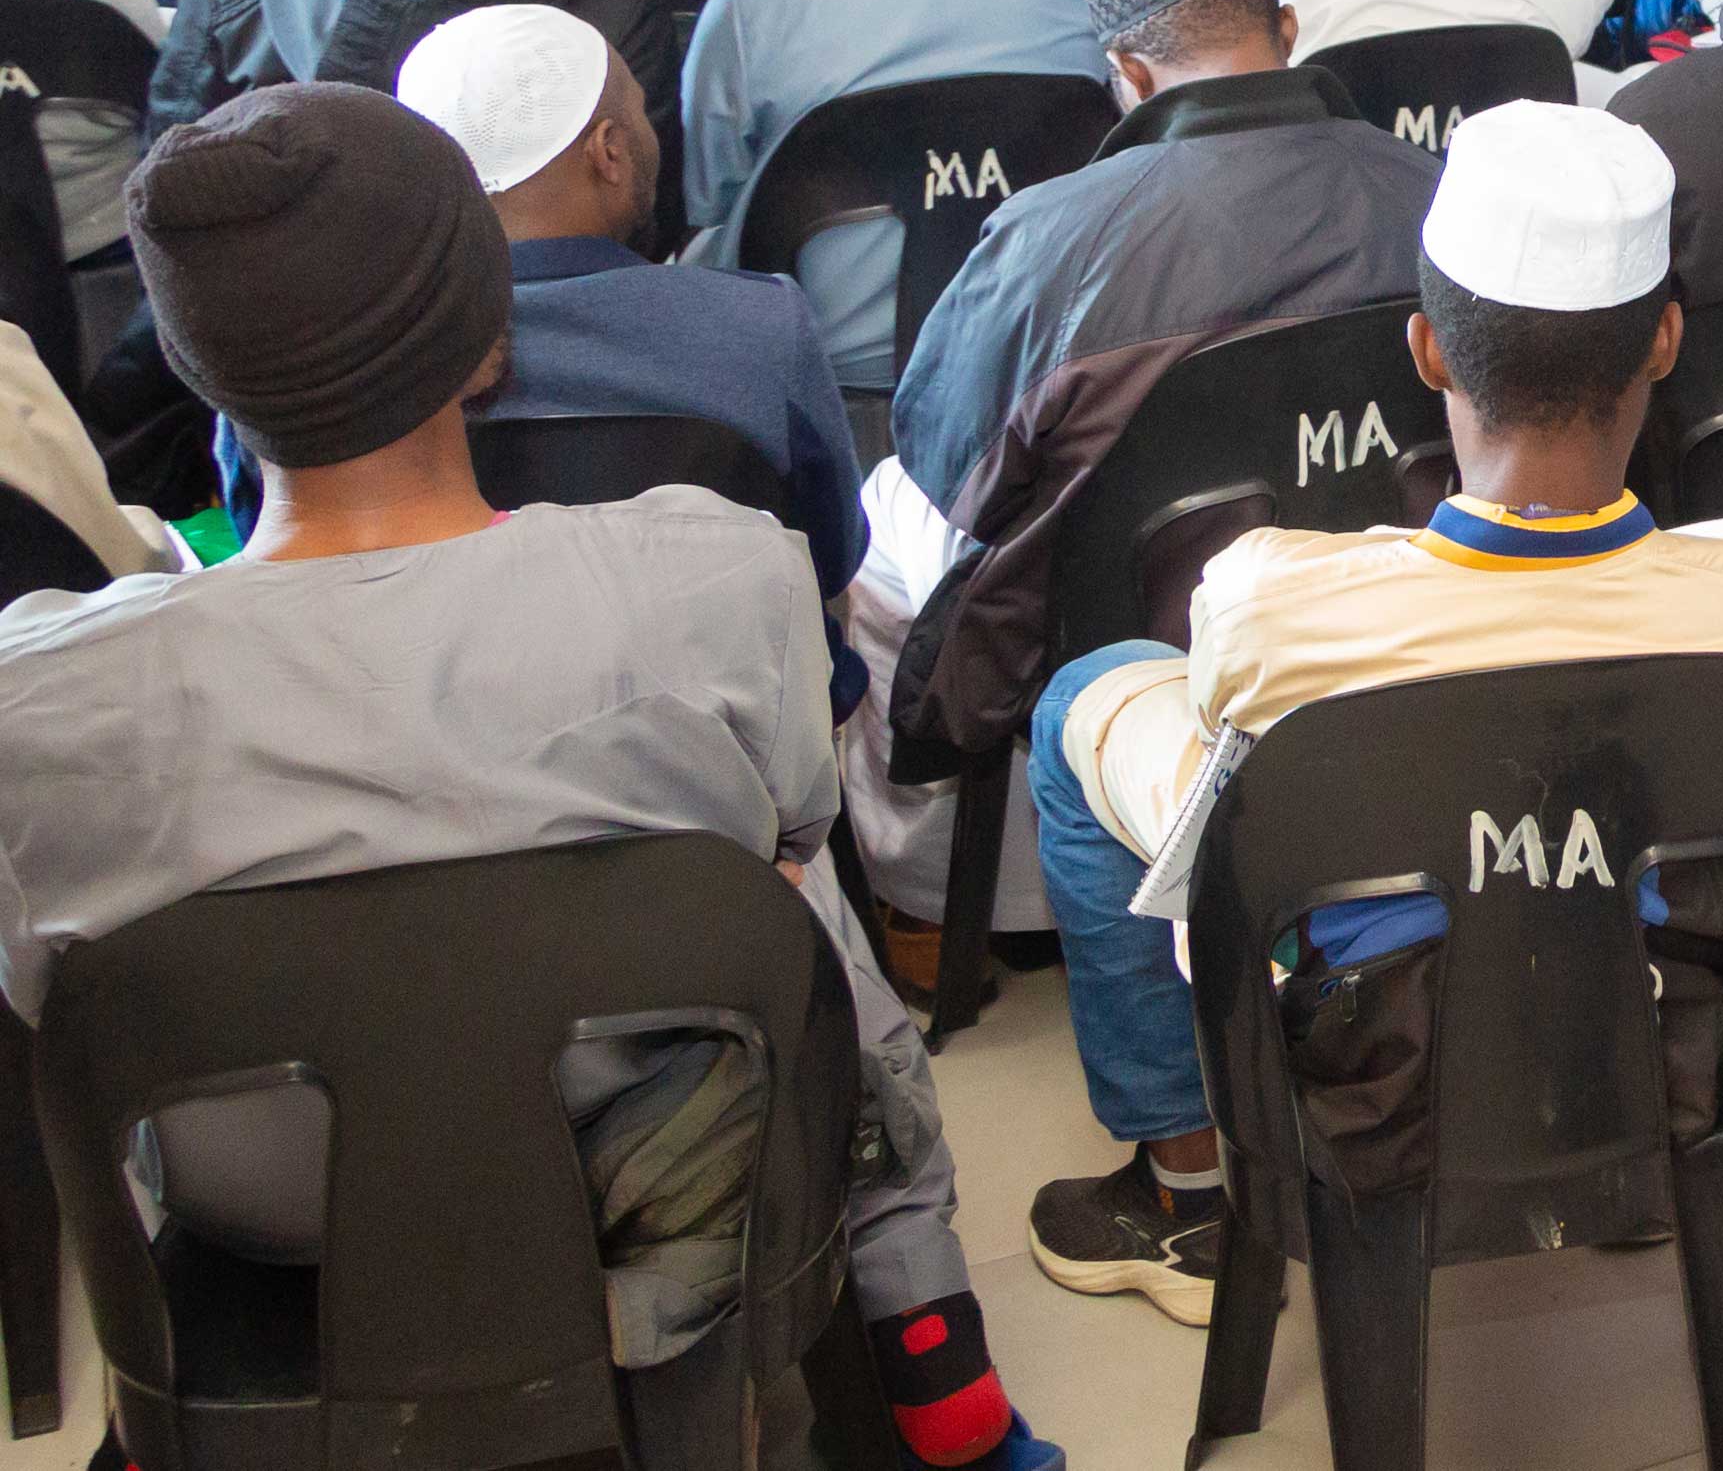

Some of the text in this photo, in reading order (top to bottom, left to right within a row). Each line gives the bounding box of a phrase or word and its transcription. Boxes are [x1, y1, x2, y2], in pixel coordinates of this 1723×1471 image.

[1394, 104, 1464, 154] MA
[924, 148, 1012, 211] MA
[1297, 400, 1399, 488] MA
[1467, 808, 1617, 893] MA
